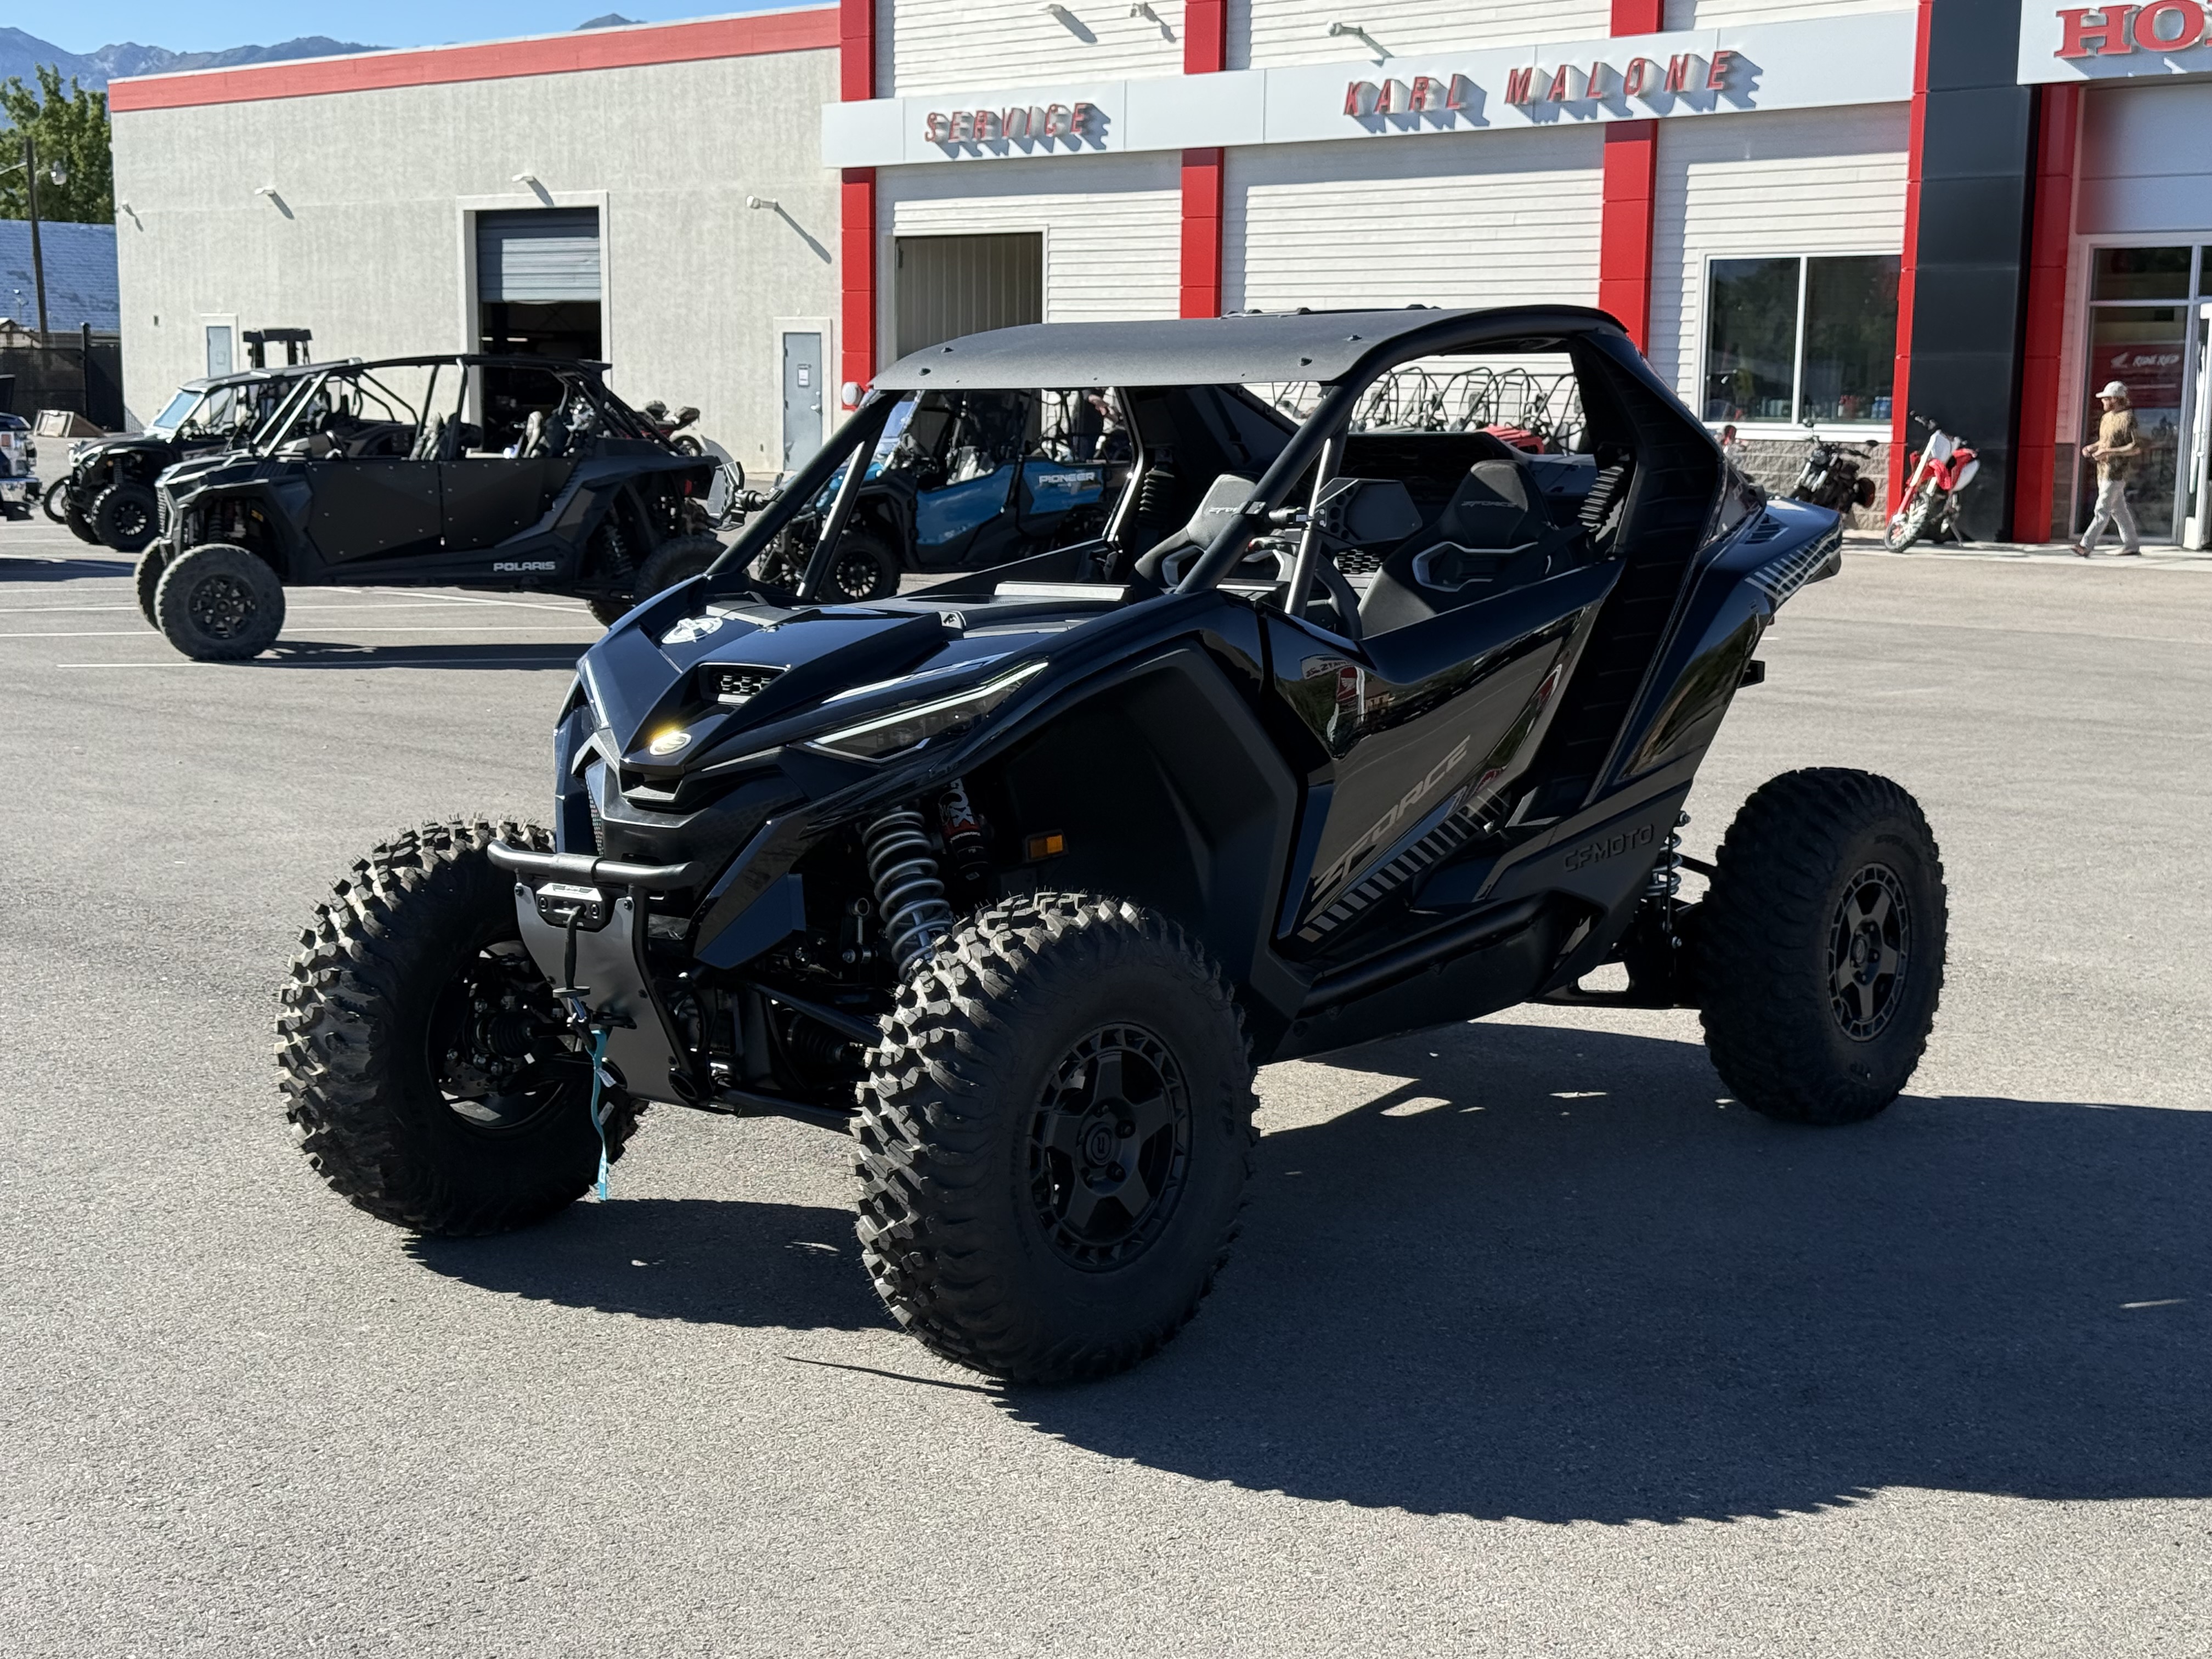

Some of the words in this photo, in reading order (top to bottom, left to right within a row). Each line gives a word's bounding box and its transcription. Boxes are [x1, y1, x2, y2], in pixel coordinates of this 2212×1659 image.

[2054, 0, 2212, 58] HO
[1343, 74, 1467, 117] KARL
[1504, 50, 1731, 104] MALONE
[924, 103, 1088, 143] SERVICE
[1039, 472, 1096, 483] PIONEER
[493, 561, 556, 572] POLARIS
[1564, 823, 1654, 872] CFMOTO
